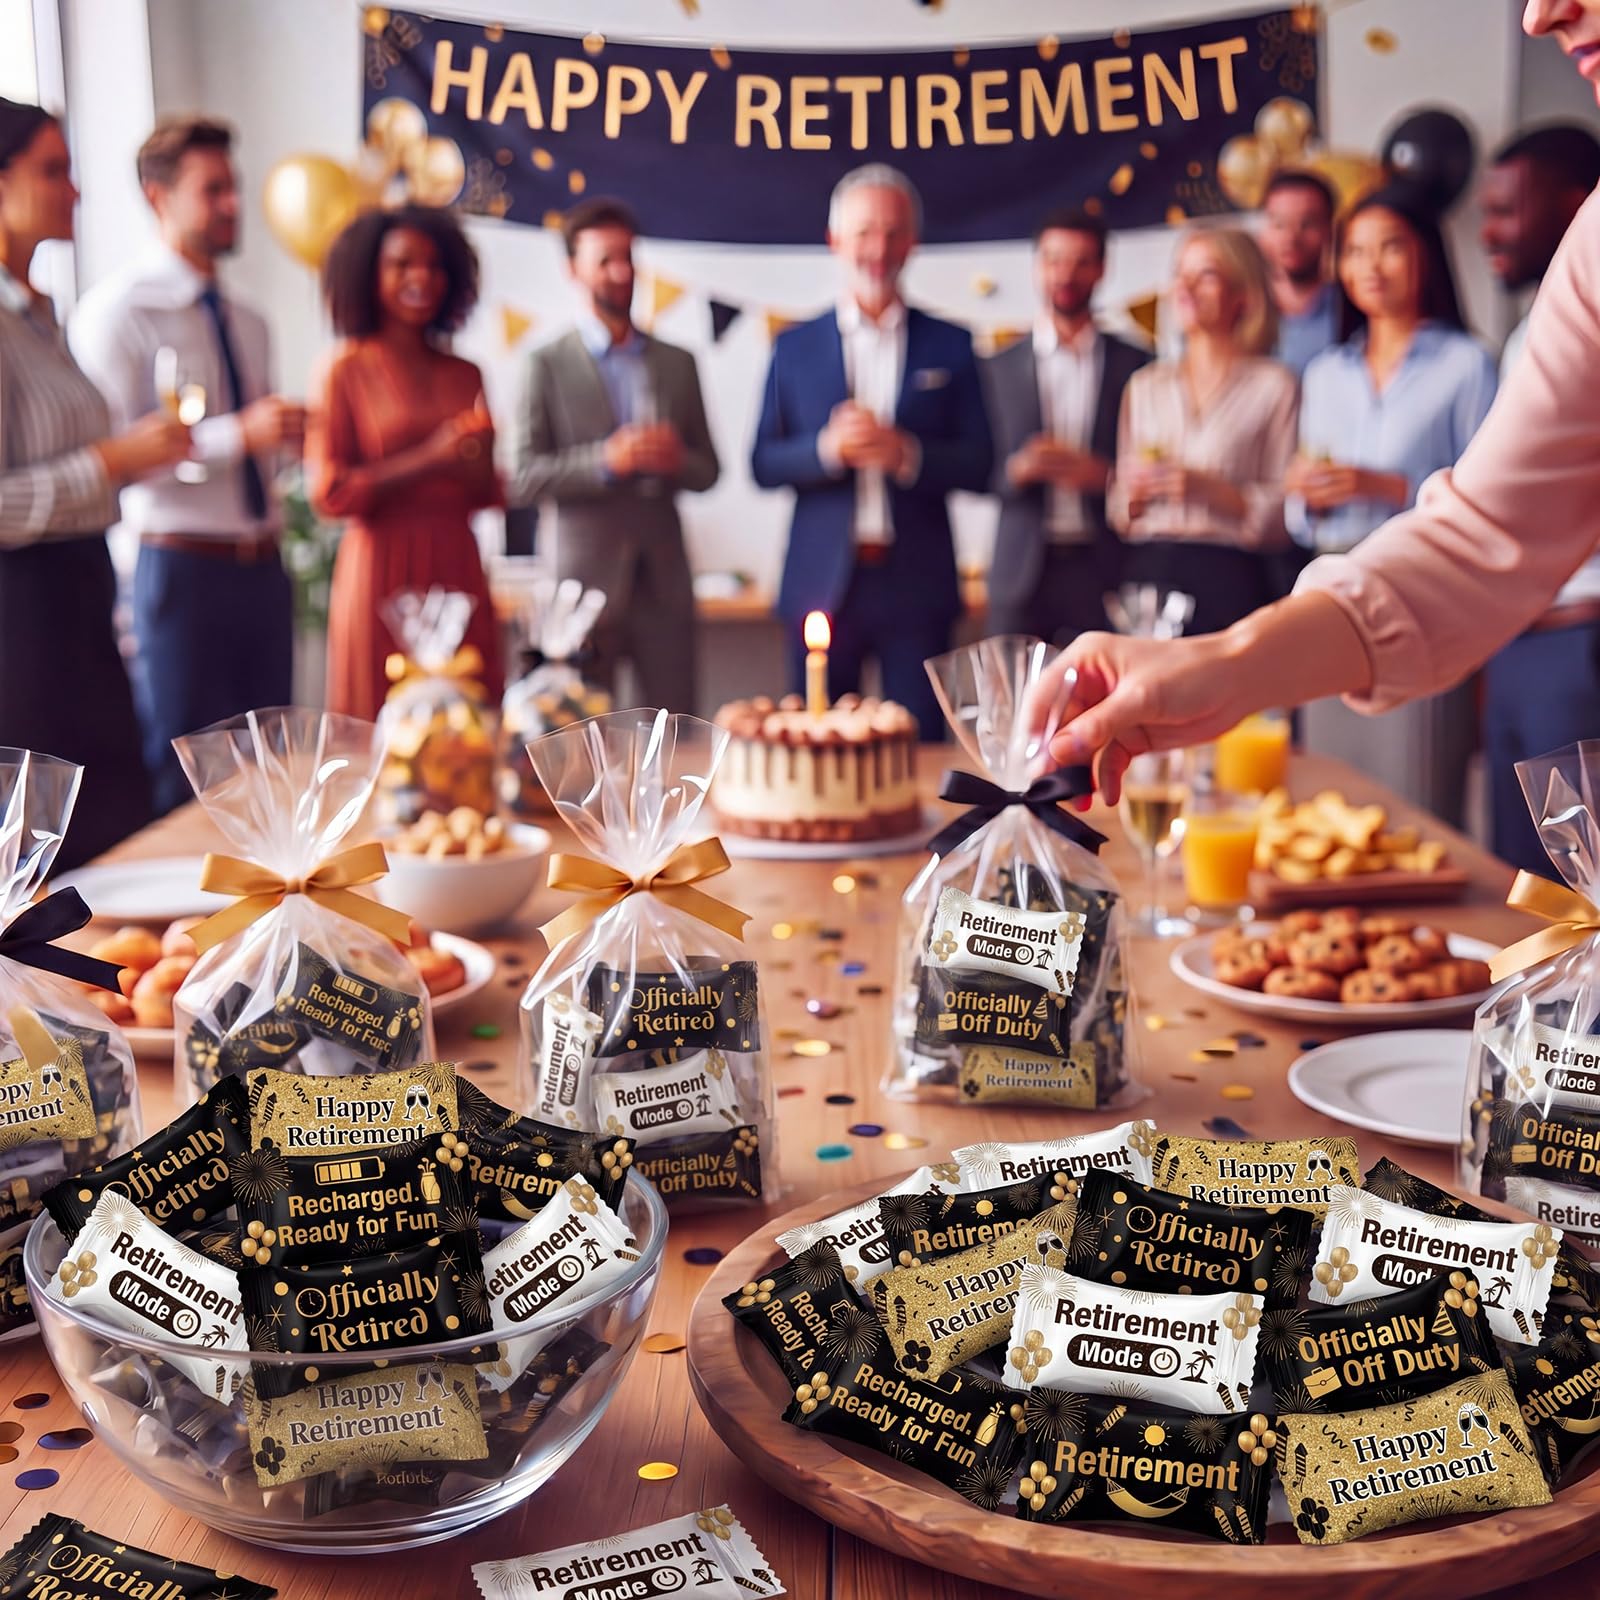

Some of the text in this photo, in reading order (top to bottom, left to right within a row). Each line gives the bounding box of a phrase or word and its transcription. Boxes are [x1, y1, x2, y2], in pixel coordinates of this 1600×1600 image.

[430, 36, 1250, 151] HAPPY RETIREMENT
[960, 911, 1058, 946] Retirement
[973, 938, 1013, 960] Mode
[295, 996, 339, 1029] Ready
[340, 1018, 360, 1038] for
[307, 983, 384, 1031] Recharged.
[628, 985, 724, 1013] Officially
[944, 991, 1032, 1019] Officially
[632, 1010, 715, 1036] Retired
[961, 1013, 1043, 1041] Off Duty
[541, 1017, 571, 1115] Retirement
[986, 1074, 1073, 1089] Retirement
[1004, 1058, 1053, 1076] Happy
[1553, 1071, 1597, 1091] Mode
[561, 1073, 578, 1105] Mode
[614, 1072, 708, 1108] Retirement
[316, 1096, 395, 1122] Happy
[635, 1106, 674, 1127] Mode
[287, 1123, 426, 1147] Retirement
[1000, 1145, 1132, 1181] Retirement
[1218, 1158, 1297, 1186] Happy
[1541, 1146, 1575, 1170] Off
[288, 1182, 419, 1218] Recharged.
[661, 1170, 738, 1193] Off Duty
[1190, 1185, 1332, 1206] Retirement
[278, 1211, 439, 1248] Ready for Fun
[1126, 1205, 1265, 1261] Officially
[1361, 1218, 1518, 1274] Retirement
[487, 1213, 588, 1301] etirement
[1130, 1239, 1241, 1286] Retired
[1382, 1259, 1436, 1285] Mod
[110, 1231, 244, 1326] Retirement
[295, 1270, 440, 1319] Officially
[510, 1276, 561, 1318] Mode
[116, 1276, 171, 1321] Mode
[310, 1307, 429, 1352] Retired
[762, 1299, 805, 1352] Ready
[1054, 1299, 1220, 1346] Retirement
[1299, 1314, 1425, 1363] Officially
[1077, 1340, 1143, 1369] Mode
[1343, 1341, 1460, 1387] Off Duty
[317, 1381, 405, 1411] Happy
[853, 1363, 972, 1436] Recharged.
[289, 1405, 445, 1447] Retirement
[830, 1385, 977, 1468] Ready for Fun
[1352, 1426, 1447, 1465] Happy
[1054, 1440, 1240, 1492] Retirement
[1328, 1449, 1498, 1506] Retirement
[48, 1545, 187, 1600] Officiall
[529, 1532, 707, 1592] Retirement
